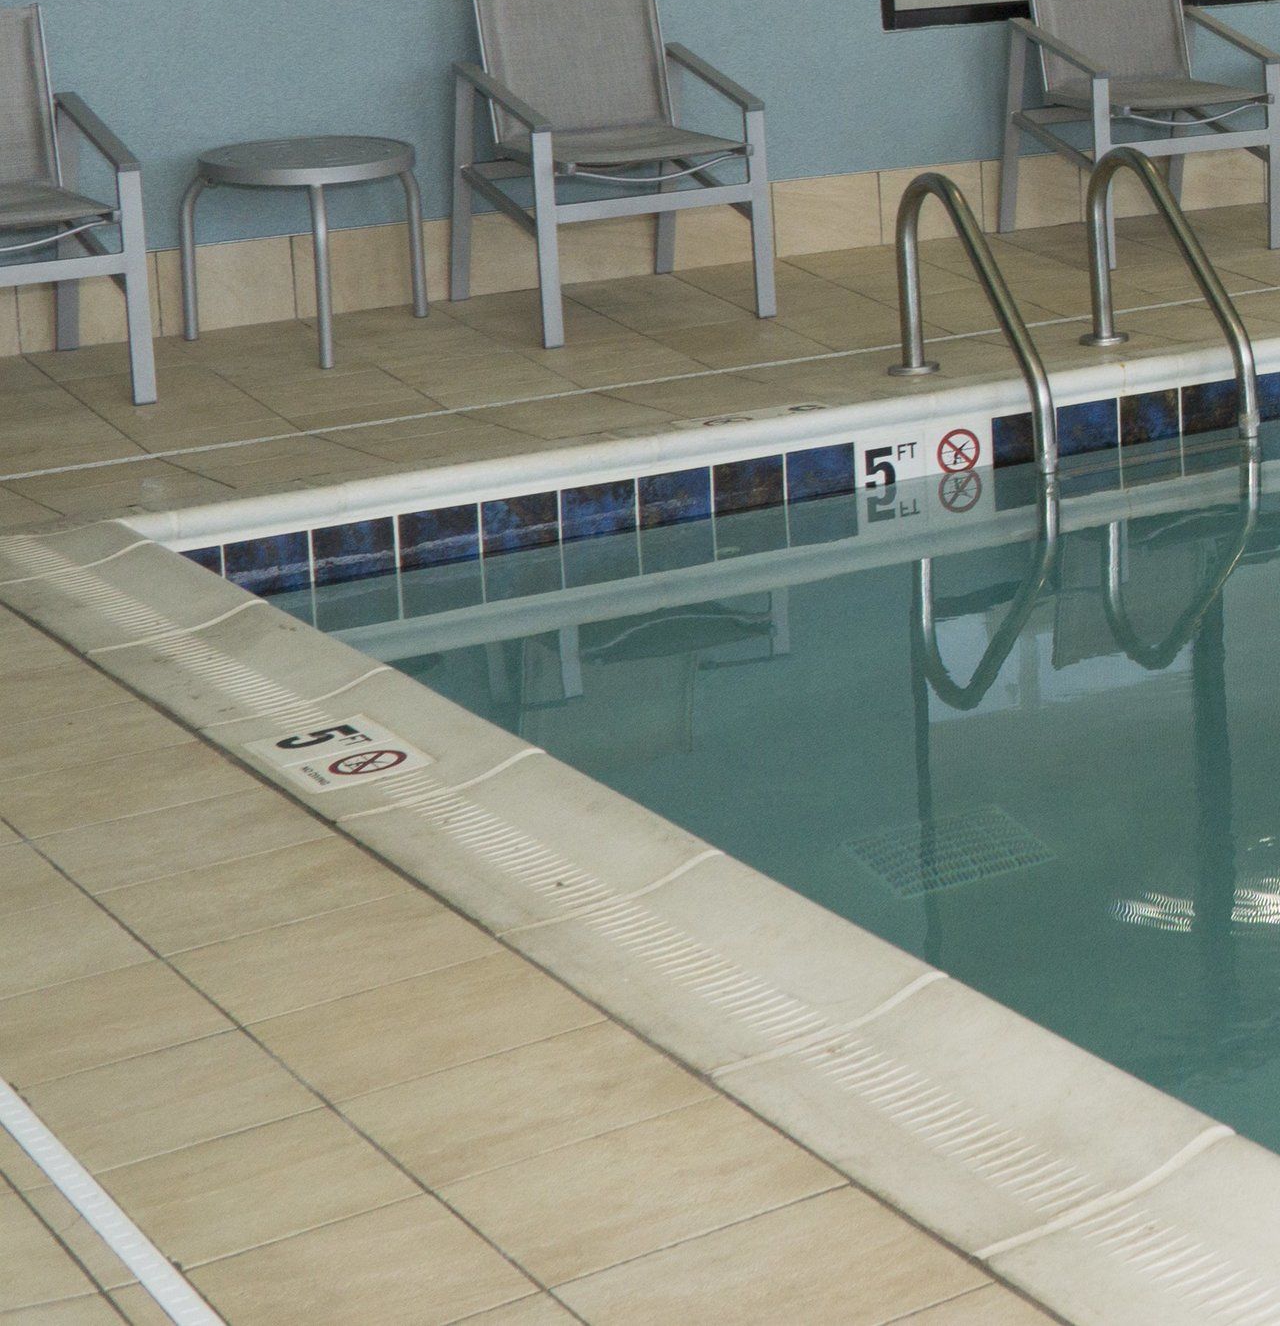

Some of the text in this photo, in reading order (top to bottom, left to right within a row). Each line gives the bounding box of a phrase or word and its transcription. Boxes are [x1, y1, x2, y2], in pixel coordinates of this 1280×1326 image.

[864, 441, 917, 489] 5 FT
[275, 724, 373, 750] 5 FT
